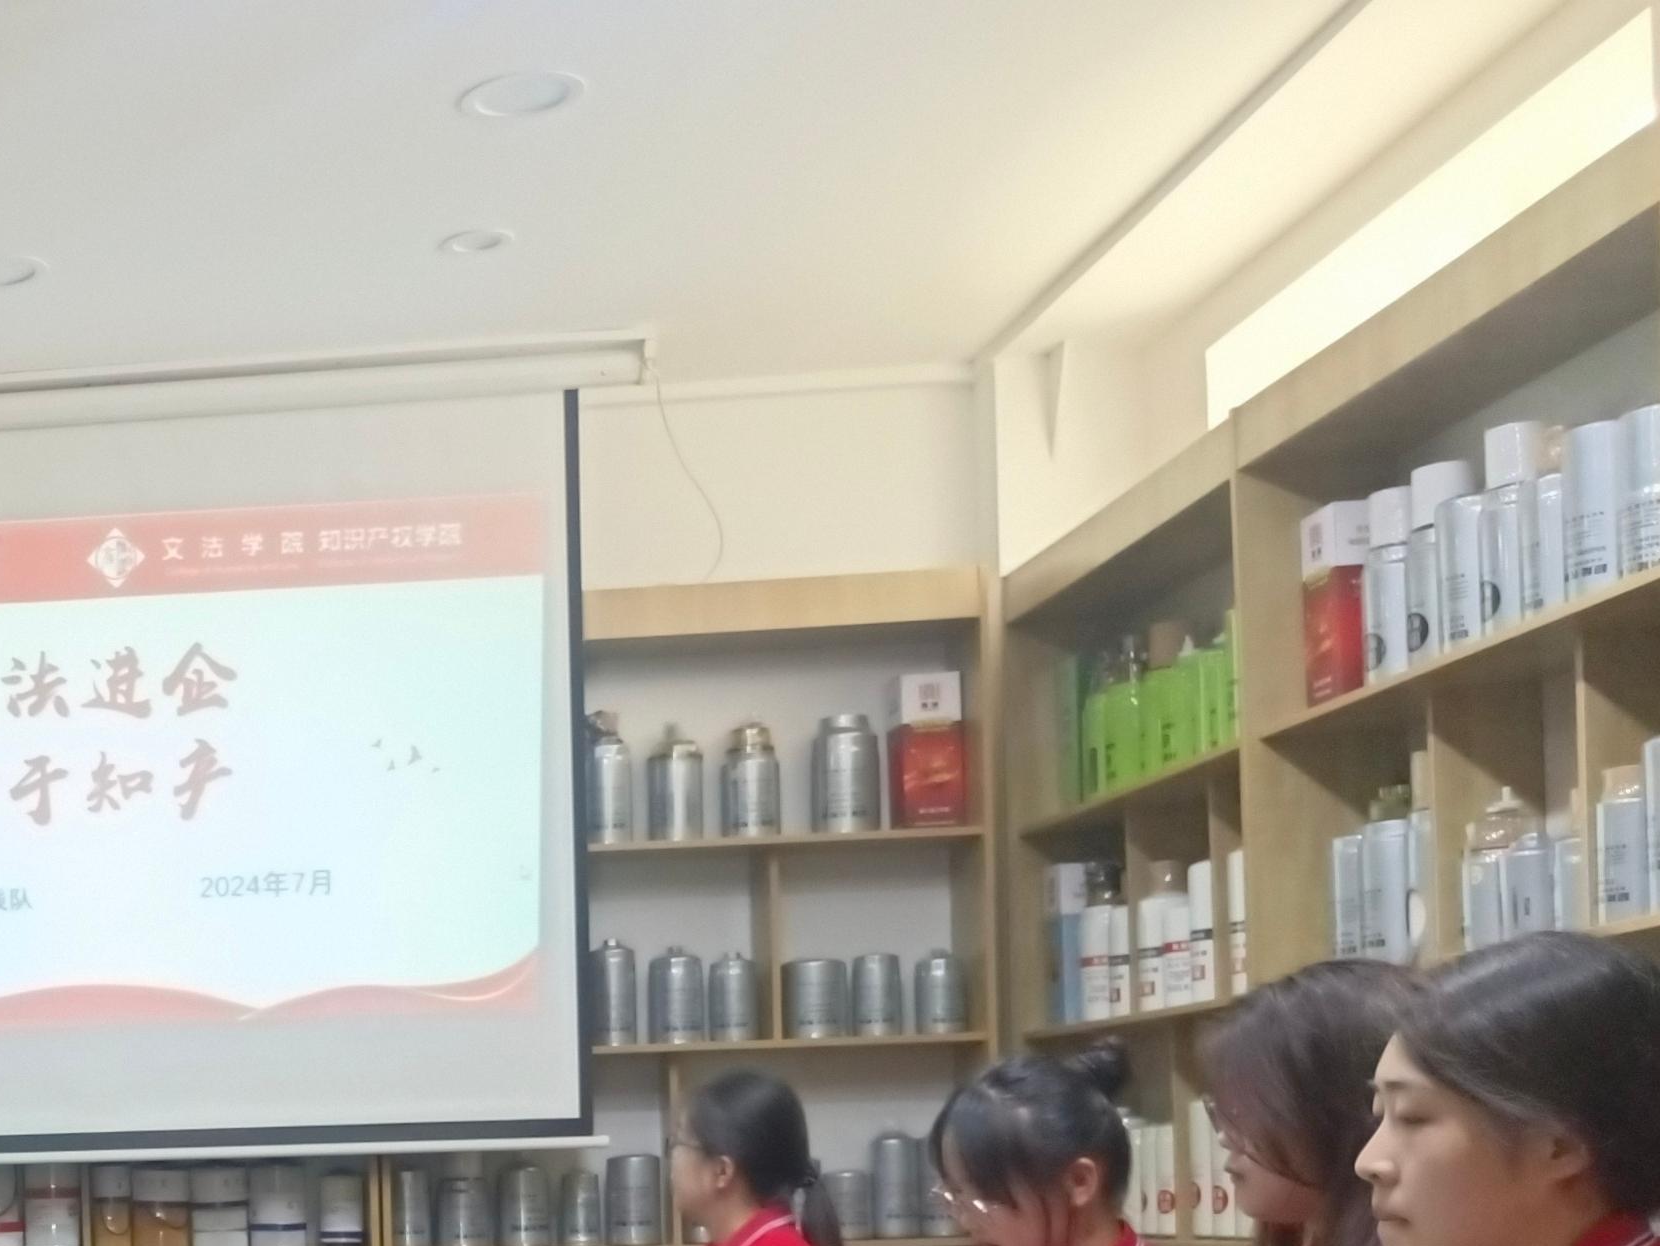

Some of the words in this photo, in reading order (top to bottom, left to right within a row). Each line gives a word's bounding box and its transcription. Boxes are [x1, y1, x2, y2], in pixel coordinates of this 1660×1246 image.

[160, 531, 304, 561] 文法学院
[317, 522, 463, 551] 知识产权学院
[200, 868, 332, 898] 2024年7月
